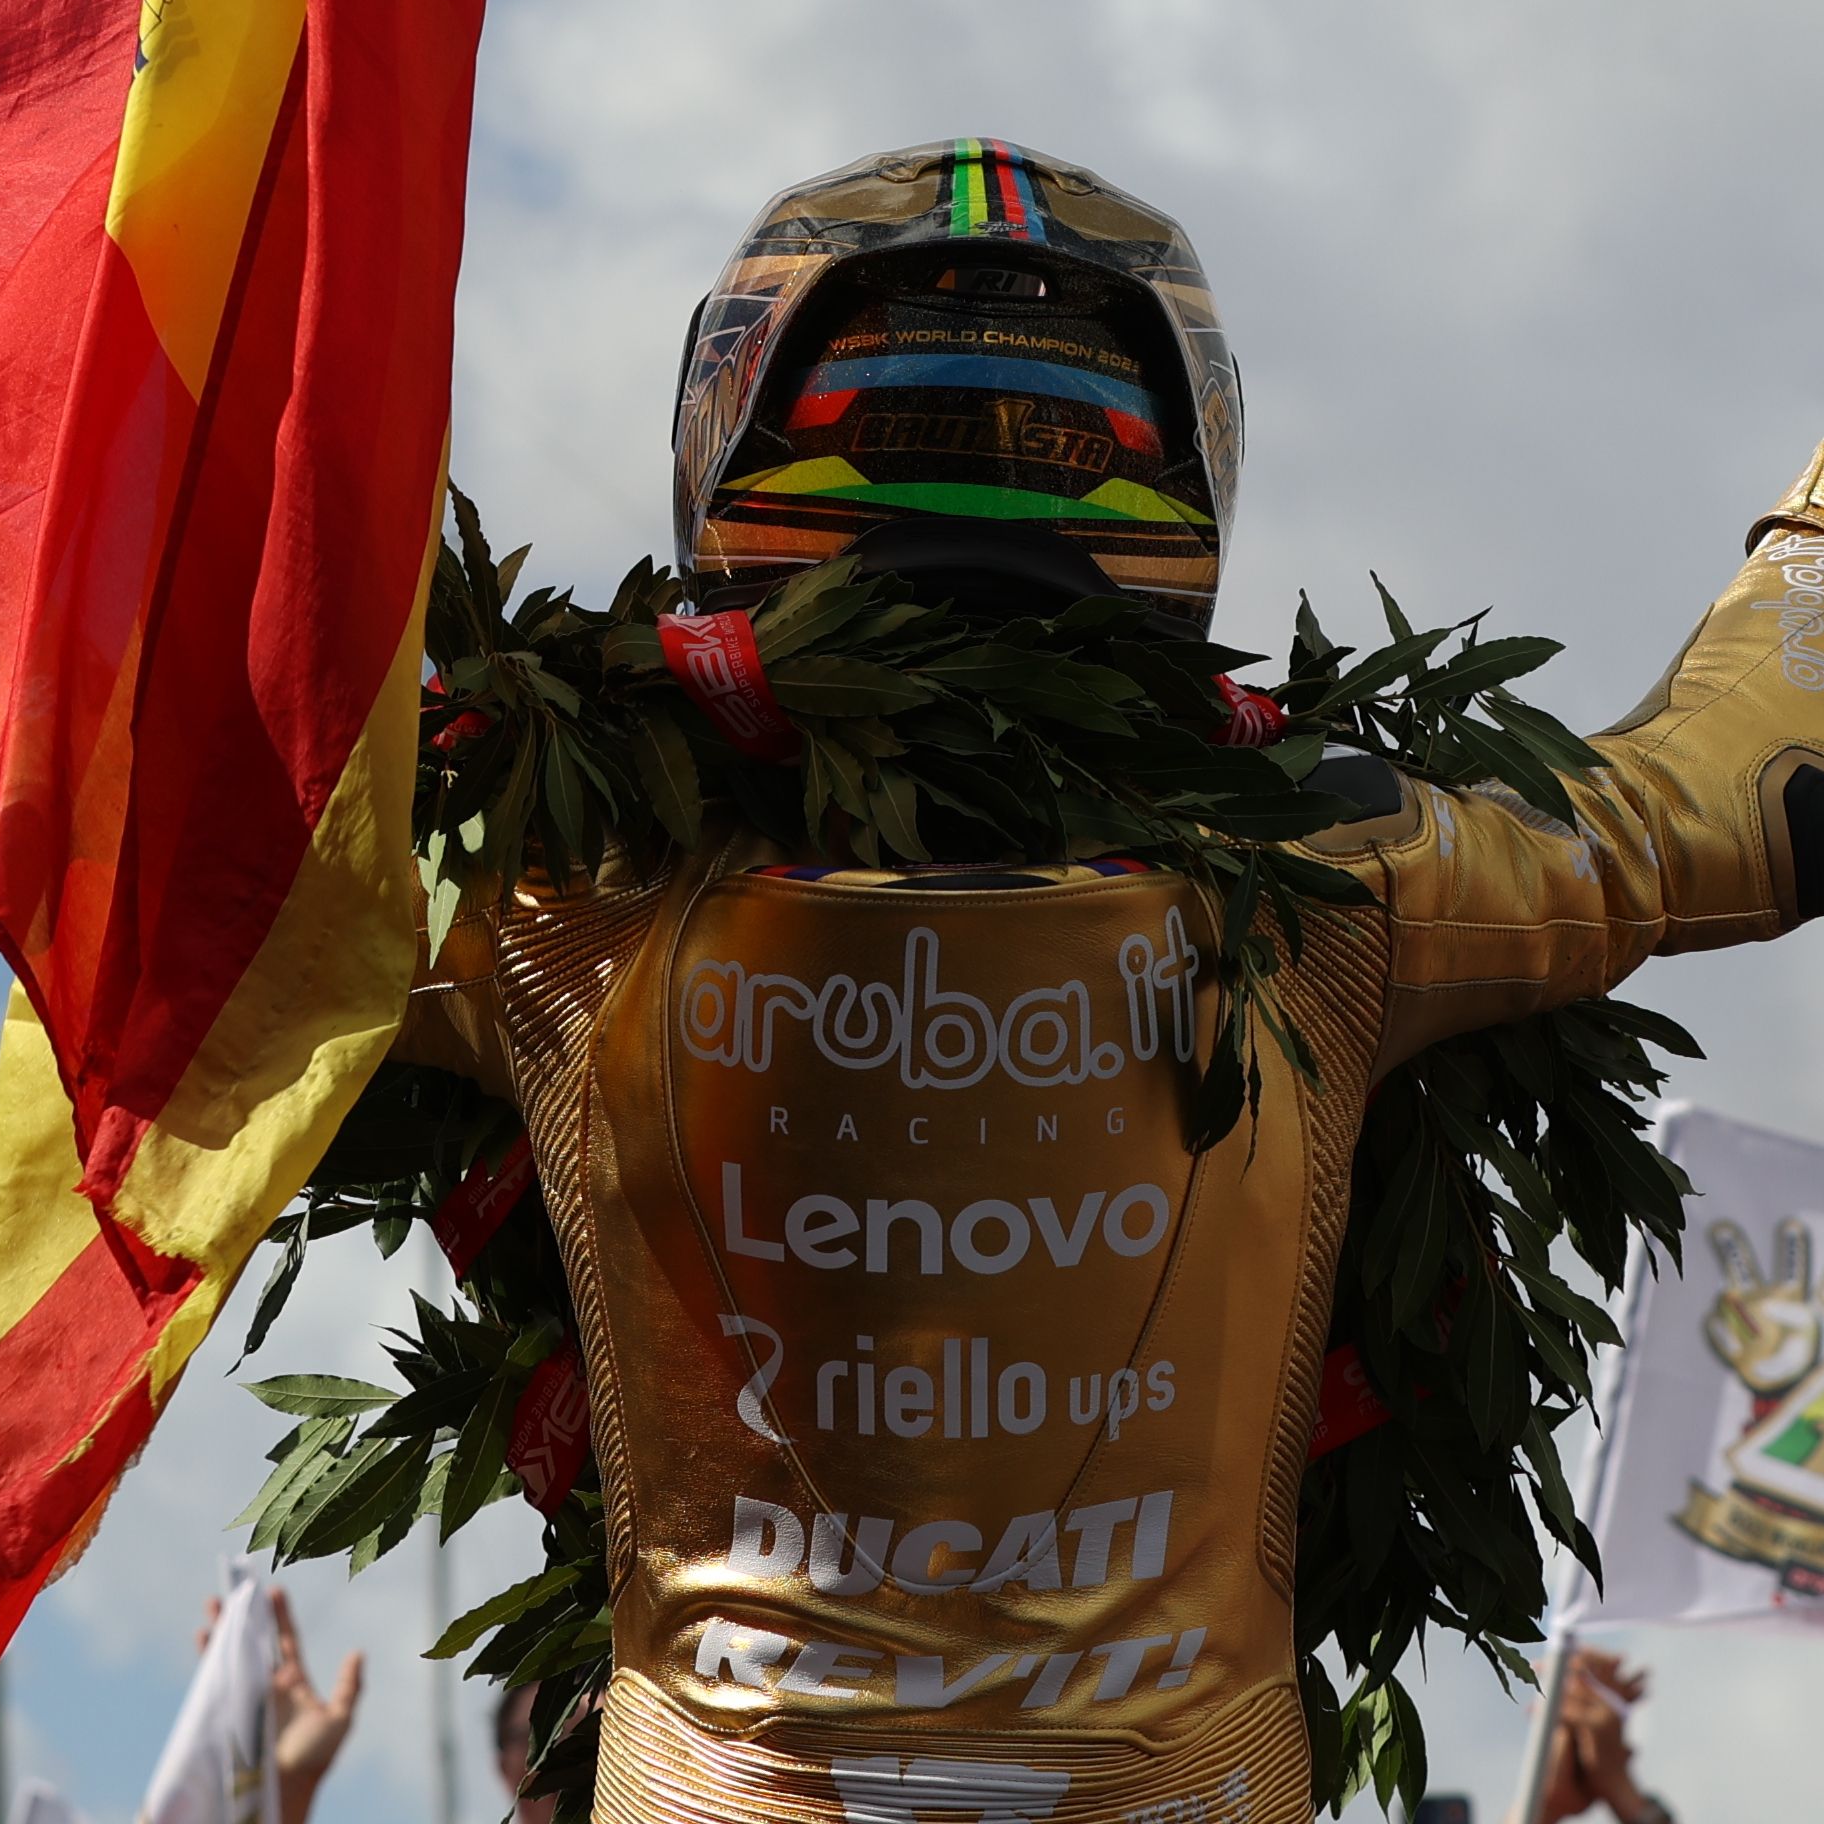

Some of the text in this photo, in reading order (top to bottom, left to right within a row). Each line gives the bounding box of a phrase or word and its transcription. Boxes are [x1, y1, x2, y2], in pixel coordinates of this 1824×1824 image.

[828, 331, 890, 352] WSBK
[894, 329, 977, 344] WORLD
[982, 329, 1093, 360] CHAMPION
[724, 634, 762, 709] SUPERBIKE
[678, 904, 1200, 1091] aruba.it
[770, 1105, 1126, 1145] RACING
[722, 1163, 1170, 1275] Lenovo
[816, 1334, 1176, 1440] riello ups
[728, 1489, 1175, 1595] DUCATI
[694, 1620, 1208, 1709] REV'IT!
